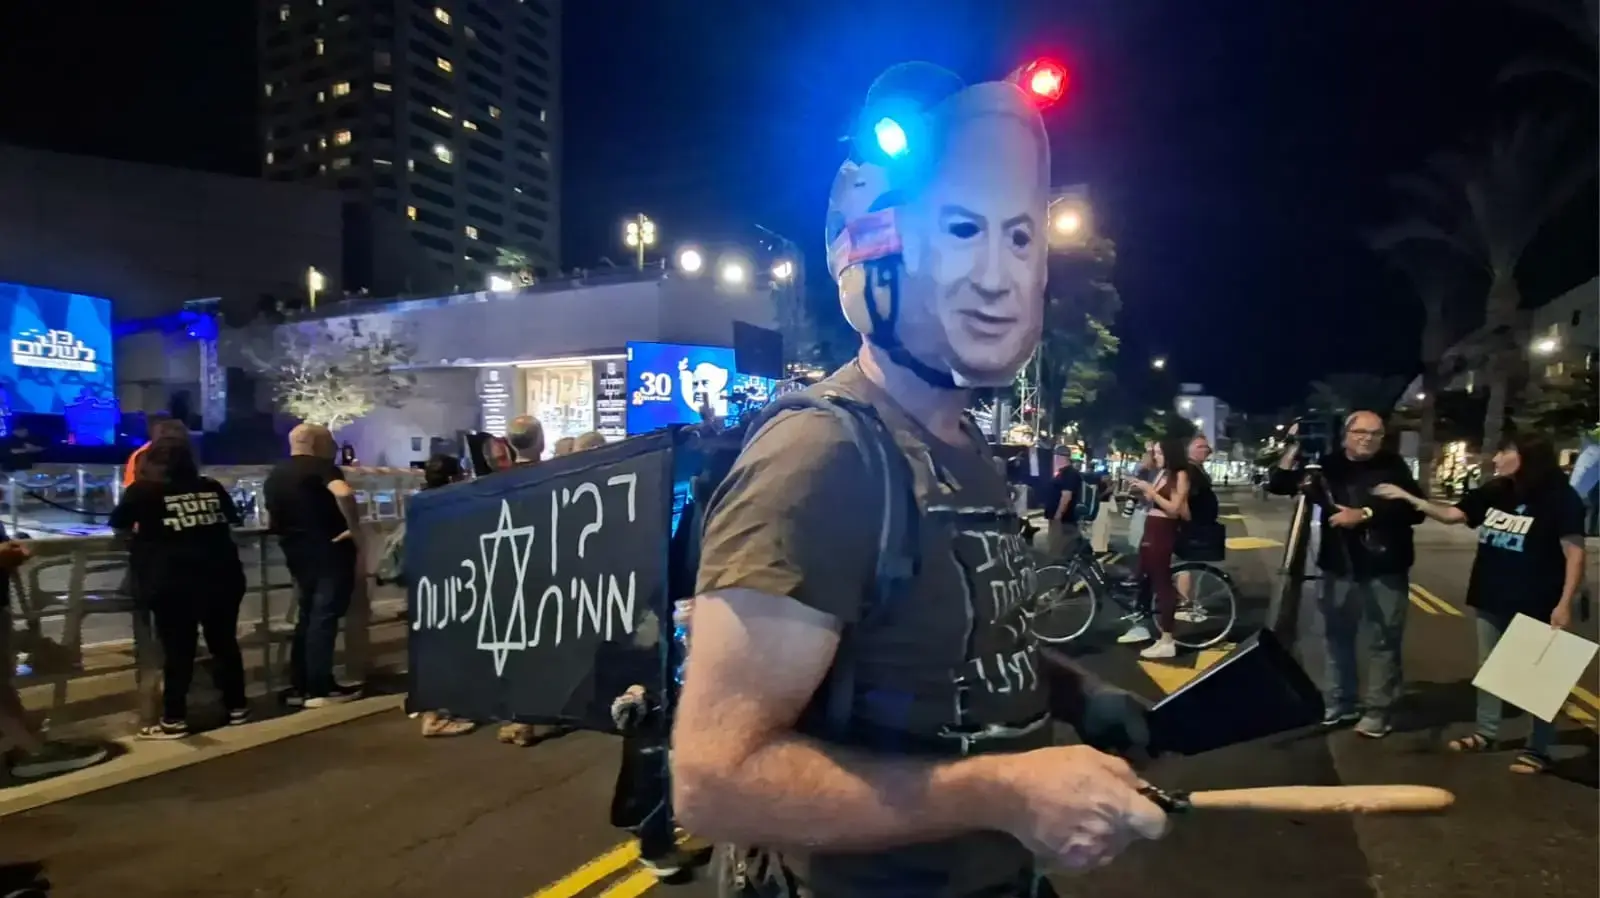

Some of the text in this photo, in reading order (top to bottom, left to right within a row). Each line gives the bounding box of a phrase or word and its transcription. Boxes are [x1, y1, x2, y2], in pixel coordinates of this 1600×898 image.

[11, 334, 97, 361] לשלום
[640, 372, 672, 396] 30
[552, 472, 637, 577] רבין
[412, 559, 636, 647] ממית ציונות
